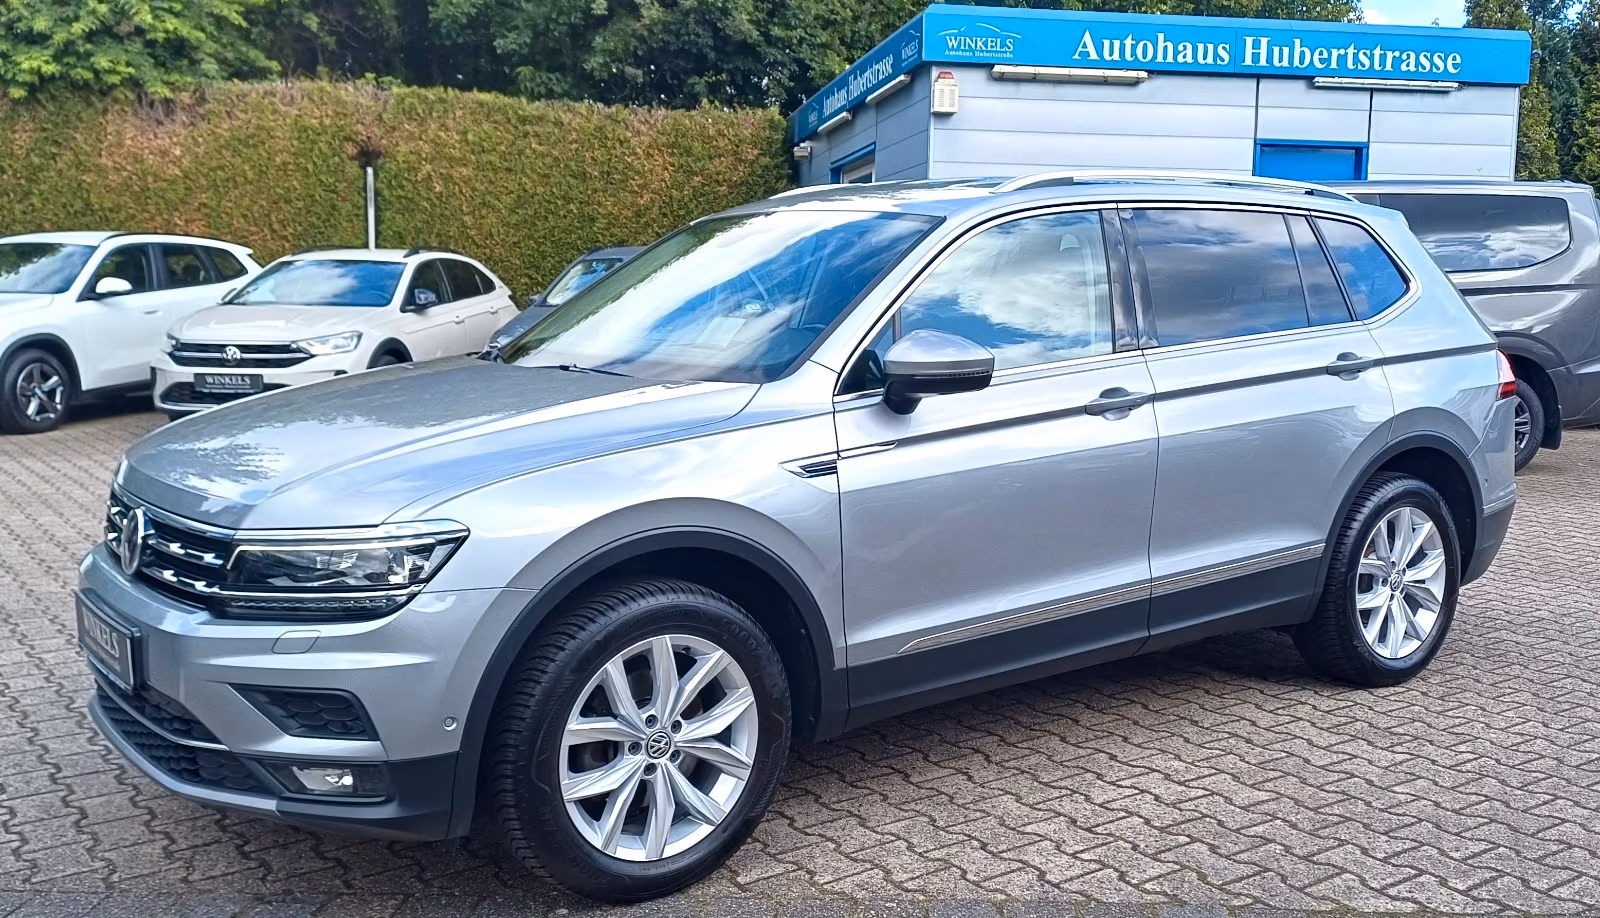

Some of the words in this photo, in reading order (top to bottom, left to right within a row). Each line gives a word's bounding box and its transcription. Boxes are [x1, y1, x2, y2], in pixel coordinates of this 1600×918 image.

[944, 49, 973, 57] Autohaus
[945, 35, 1015, 52] WINKELS
[1072, 28, 1231, 66] Autohaus
[1241, 36, 1463, 74] Hubertstrasse
[822, 86, 848, 118] Autohaus
[848, 53, 894, 101] Hubertstrasse
[204, 375, 251, 385] WINKELS
[81, 606, 120, 658] WINKELS
